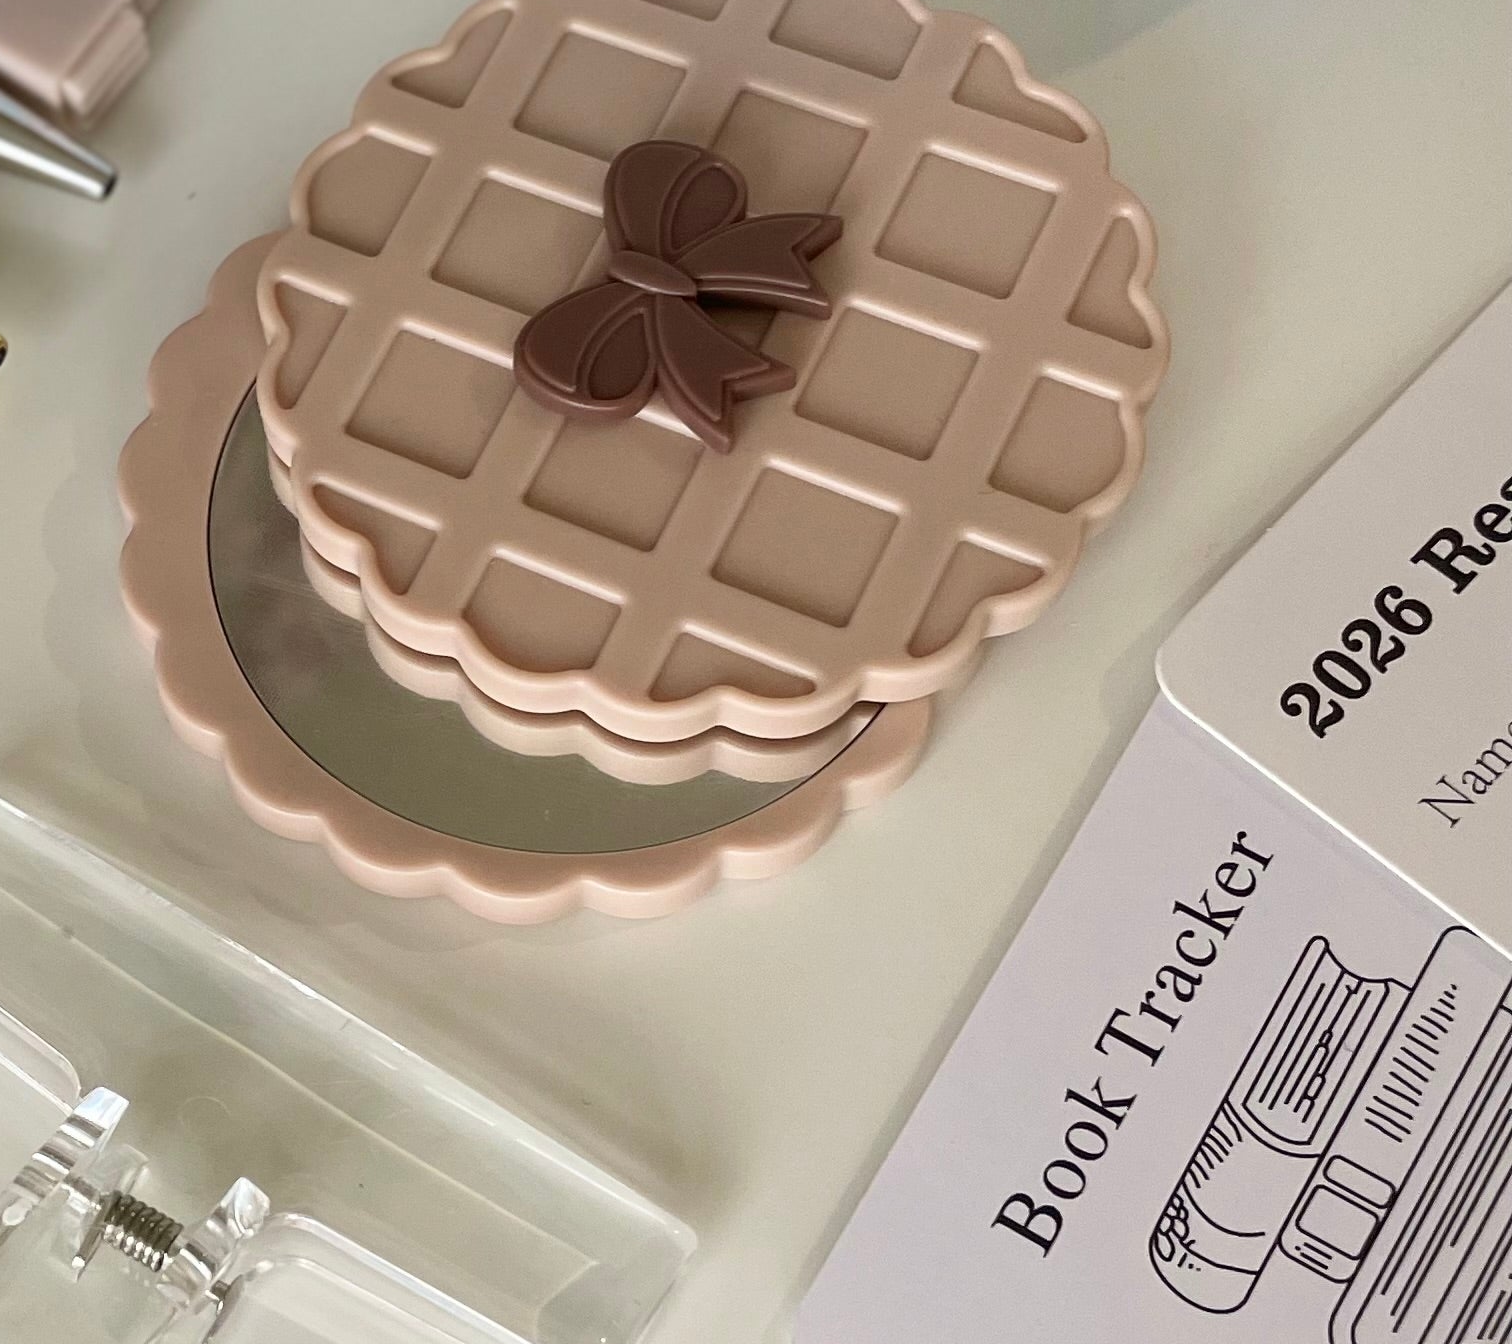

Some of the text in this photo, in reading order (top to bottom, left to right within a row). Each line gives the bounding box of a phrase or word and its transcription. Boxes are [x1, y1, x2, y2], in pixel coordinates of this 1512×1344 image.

[1280, 585, 1433, 739] 2026
[1417, 722, 1512, 828] Nam
[990, 830, 1274, 1258] Book Tracker
